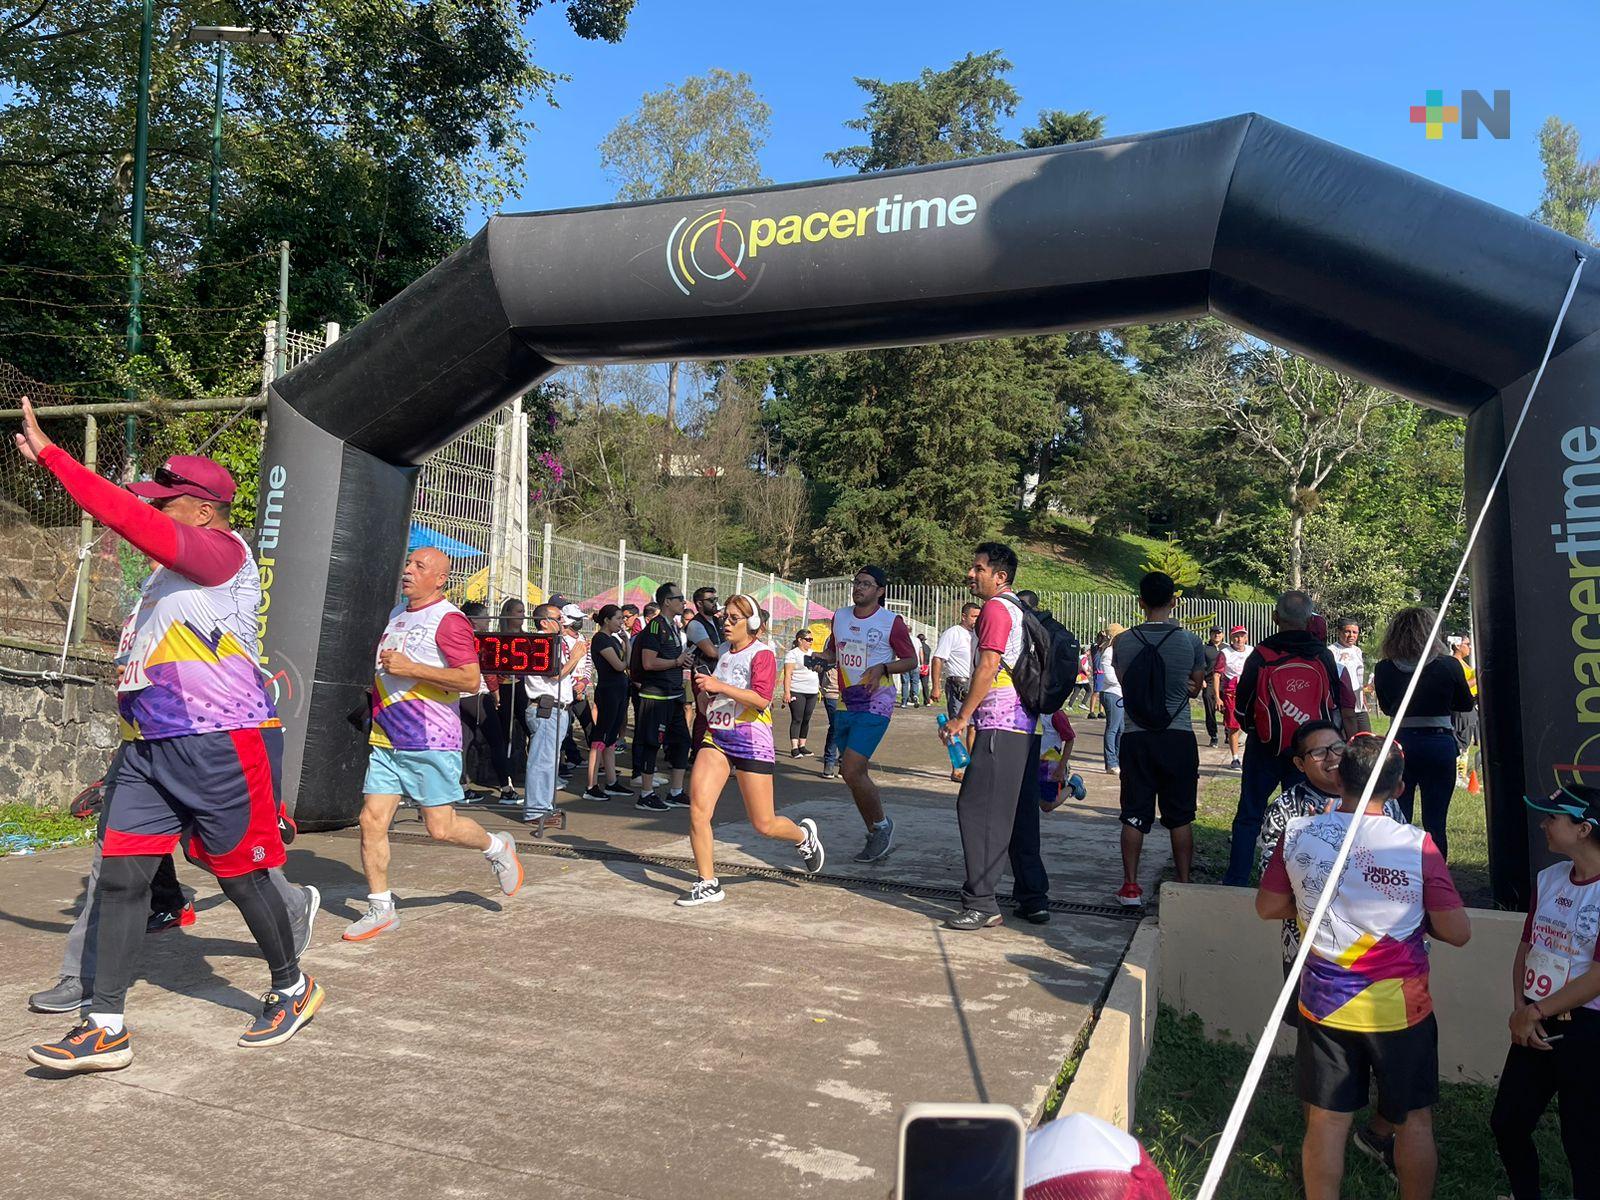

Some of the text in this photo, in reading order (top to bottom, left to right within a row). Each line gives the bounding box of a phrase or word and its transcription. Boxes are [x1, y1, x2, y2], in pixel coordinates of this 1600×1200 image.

[748, 193, 977, 258] pacertime
[474, 636, 550, 671] 7:53
[841, 653, 862, 668] 1030
[707, 710, 731, 727] 230
[1362, 872, 1410, 887] TODOS
[1367, 866, 1407, 878] UNIDOS
[1524, 966, 1552, 997] 99
